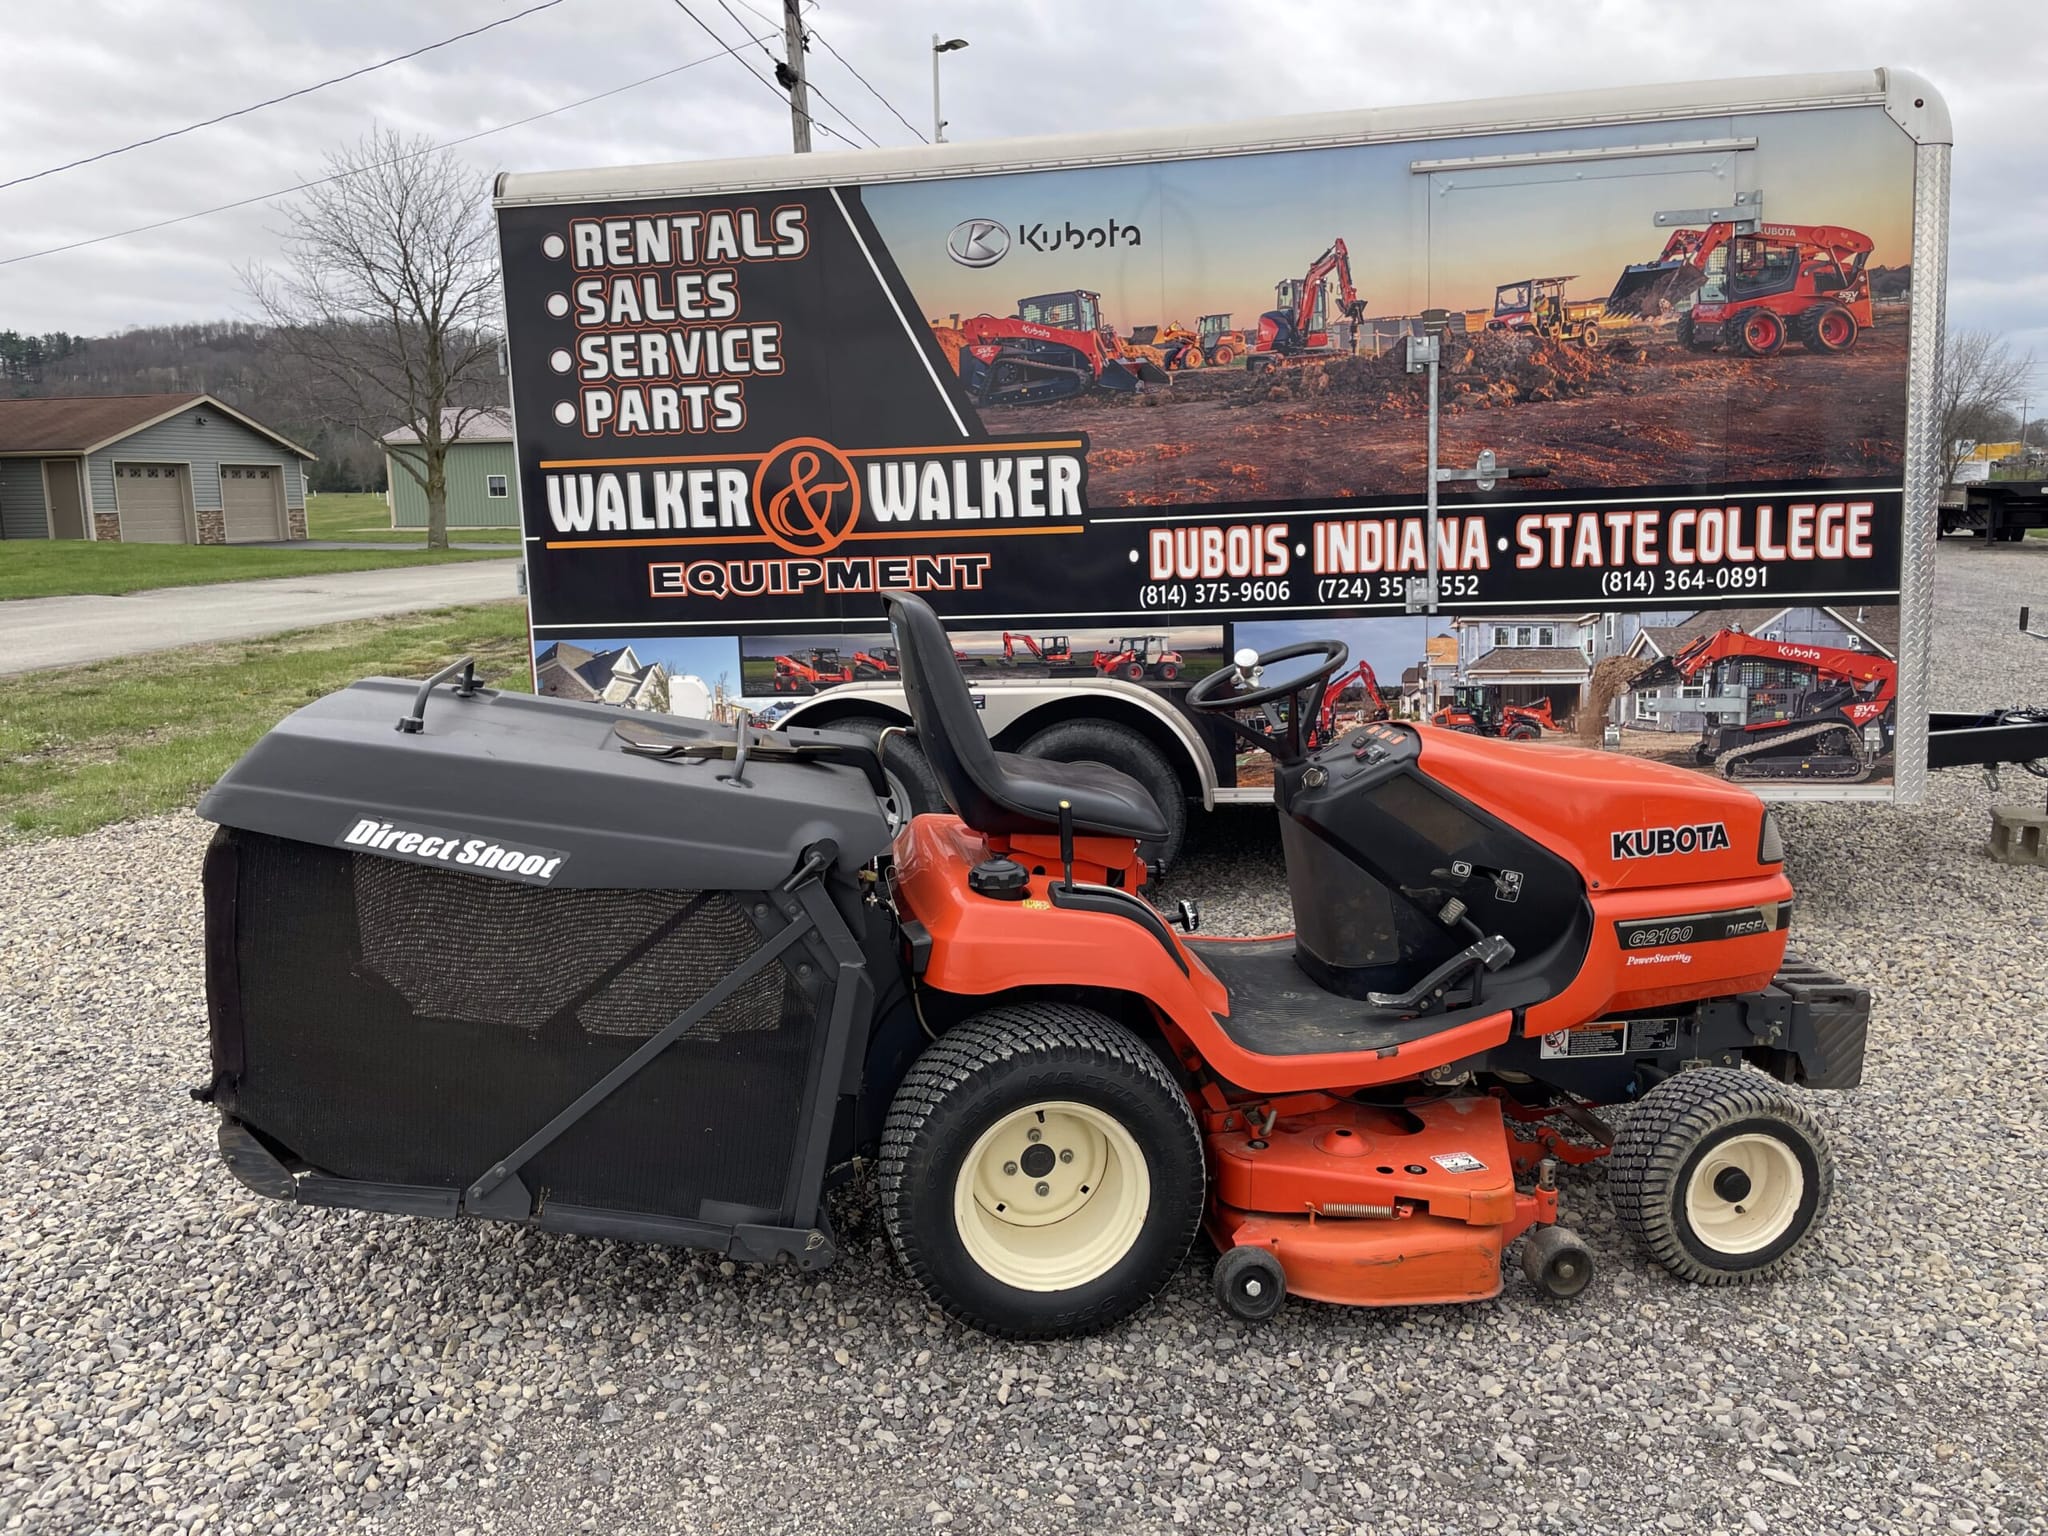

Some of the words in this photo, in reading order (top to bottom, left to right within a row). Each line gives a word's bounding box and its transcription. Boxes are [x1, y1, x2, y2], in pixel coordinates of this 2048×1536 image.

[574, 208, 806, 268] RENTALS
[1019, 219, 1141, 252] Kubota
[577, 273, 737, 326] SALES
[1838, 290, 1859, 298] SSV
[1022, 324, 1051, 338] Kubota
[580, 327, 781, 379] SERVICE
[584, 384, 743, 433] PARTS
[546, 468, 751, 532] WALKER
[867, 455, 1082, 522] WALKER
[1149, 523, 1290, 581] DUBOIS
[1515, 510, 1660, 569] STATE
[1668, 501, 1875, 564] COLLEGE
[649, 552, 991, 599] EQUIPMENT
[1318, 578, 1371, 603] (724)
[1601, 571, 1656, 596] (814)
[1663, 565, 1769, 592] 364-0891
[1139, 585, 1187, 608] (814)
[1194, 580, 1291, 603] 375-9606
[1777, 645, 1820, 660] Kubota
[1853, 704, 1879, 712] SVL
[344, 819, 460, 861] Direct
[455, 839, 561, 879] Shoot
[1611, 821, 1731, 860] KUBOTA
[1628, 925, 1693, 947] G2160
